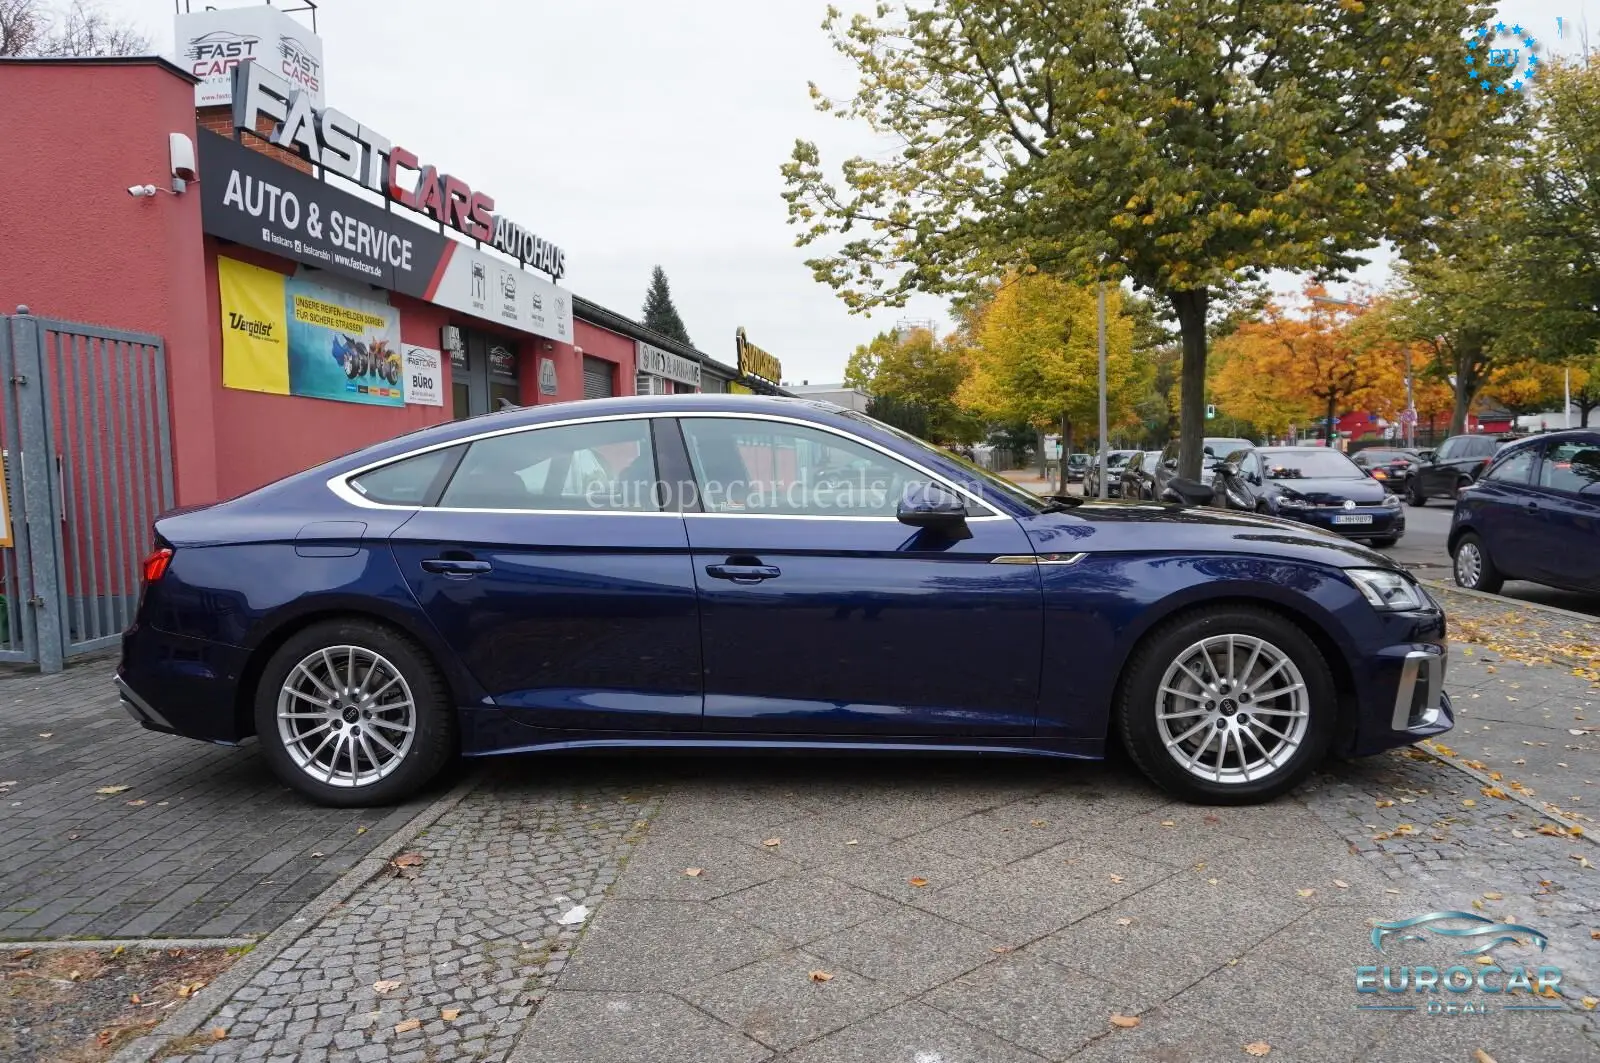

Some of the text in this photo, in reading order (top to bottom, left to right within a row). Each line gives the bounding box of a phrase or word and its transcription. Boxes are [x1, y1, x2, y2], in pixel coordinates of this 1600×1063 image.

[191, 40, 258, 60] FAST
[281, 43, 319, 76] FAST
[193, 57, 256, 76] CAR
[282, 60, 319, 92] CARS
[223, 169, 412, 271] AUTO & SERVICE
[271, 232, 293, 249] fastcars
[335, 253, 382, 278] www.fastcars.de
[492, 215, 566, 279] AUTOHAUS
[295, 297, 320, 312] UNSERE
[228, 311, 273, 337] Vergölst
[309, 311, 335, 327] SICHERE
[412, 372, 433, 390] BÜRO
